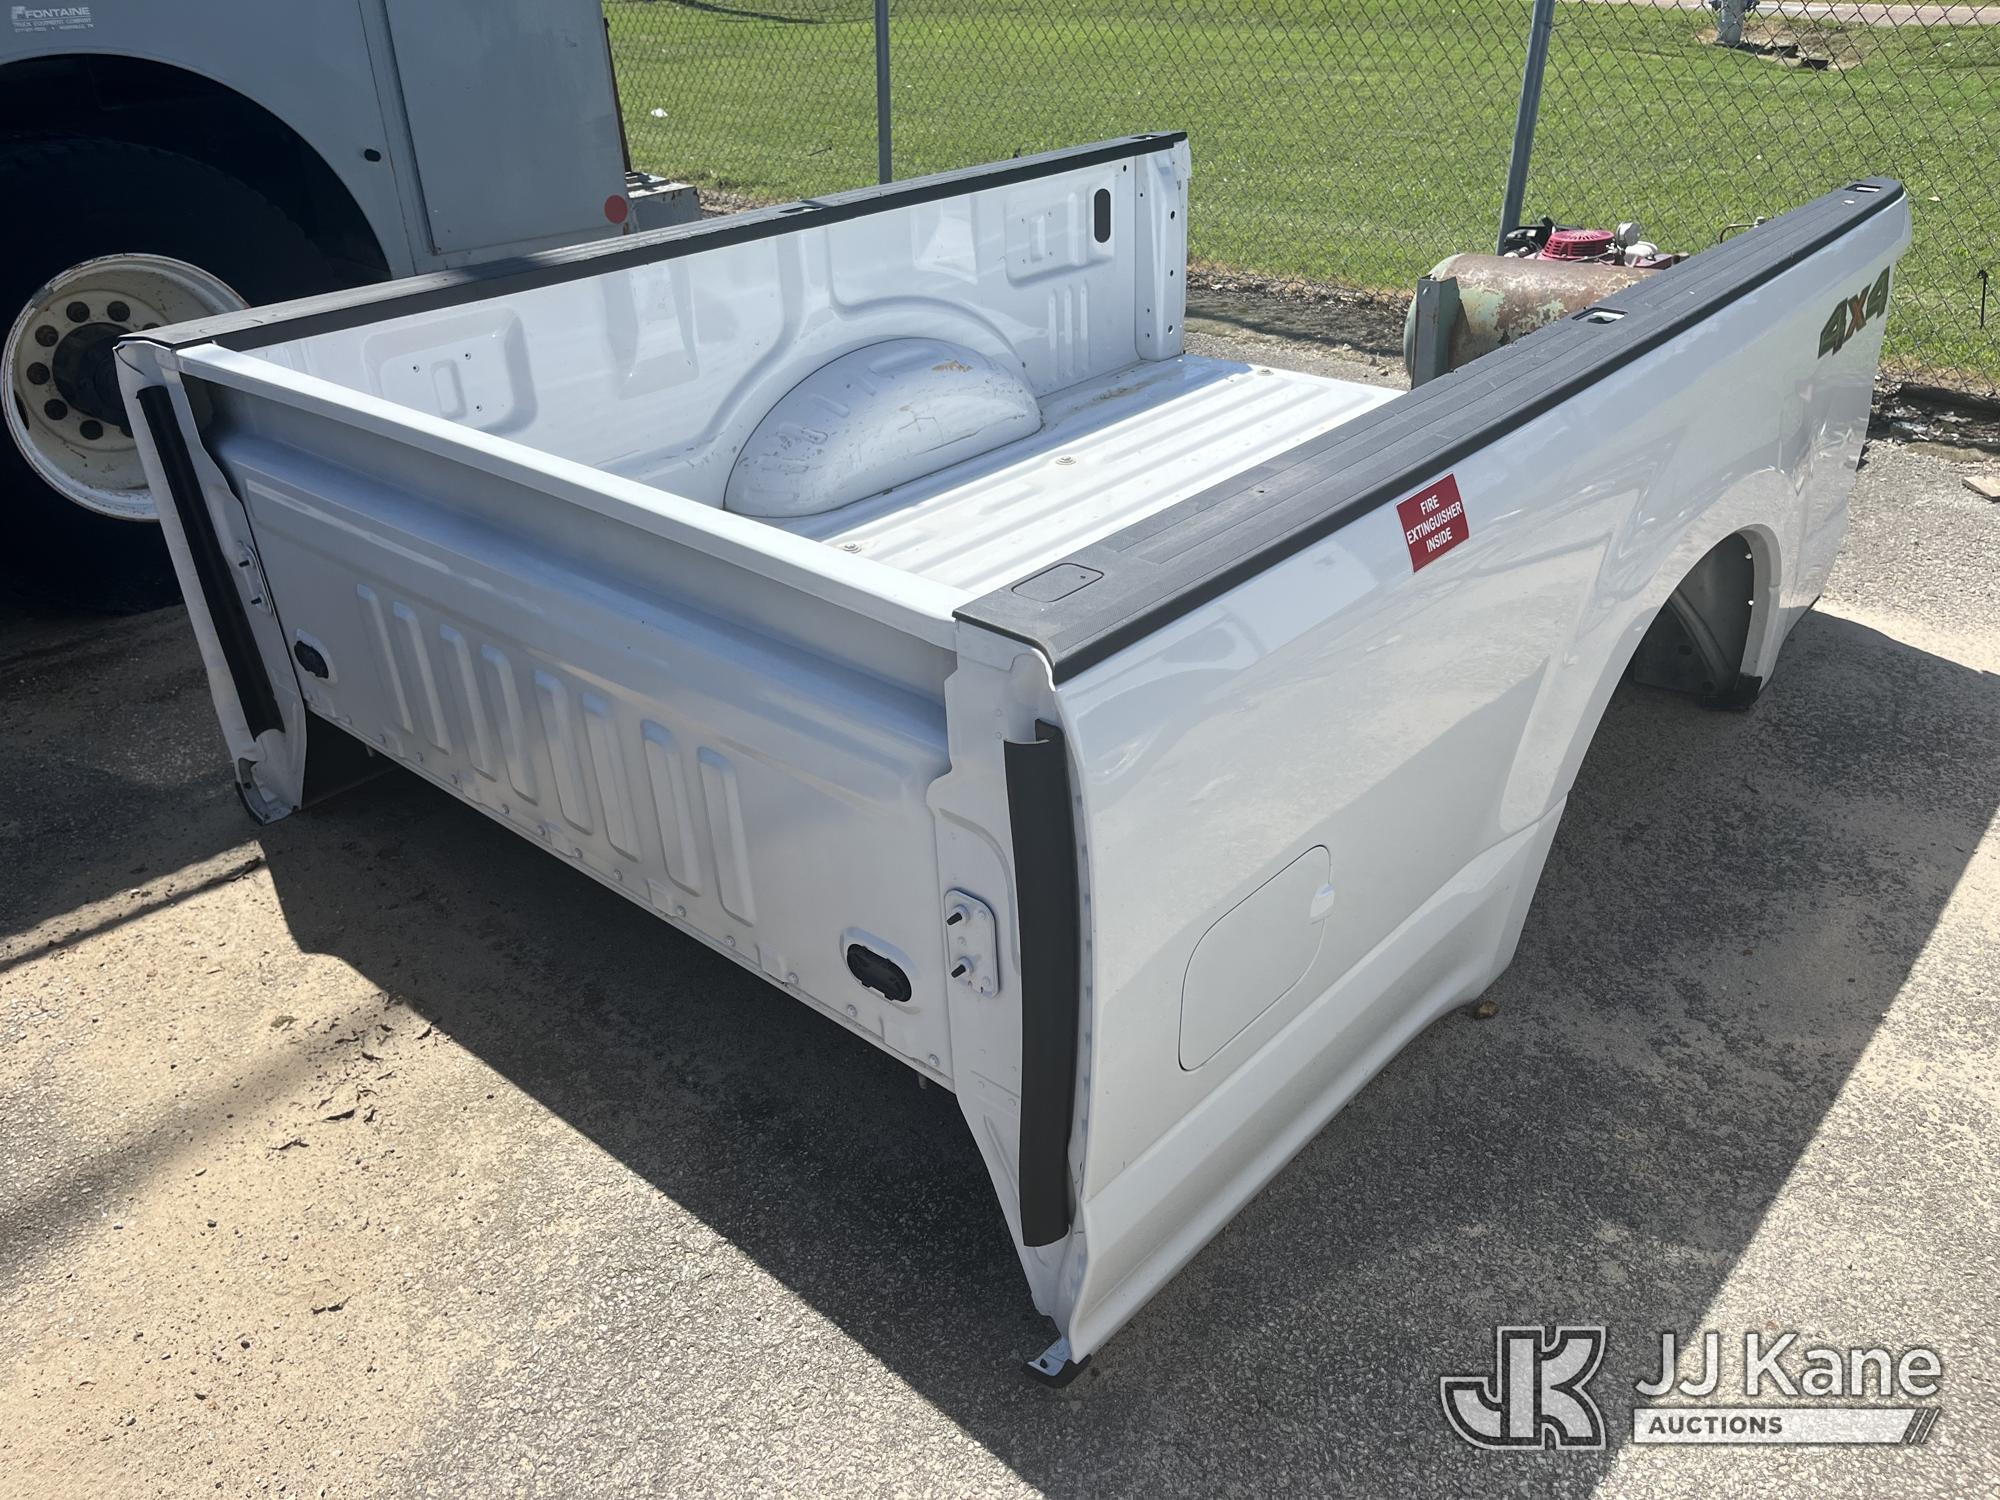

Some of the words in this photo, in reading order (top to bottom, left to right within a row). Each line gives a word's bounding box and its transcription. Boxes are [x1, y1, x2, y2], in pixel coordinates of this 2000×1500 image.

[25, 7, 91, 18] FONTAINE
[1420, 494, 1440, 515] FIRE
[1406, 501, 1463, 545] EXTINGUISHER
[1426, 527, 1453, 553] INSIDE
